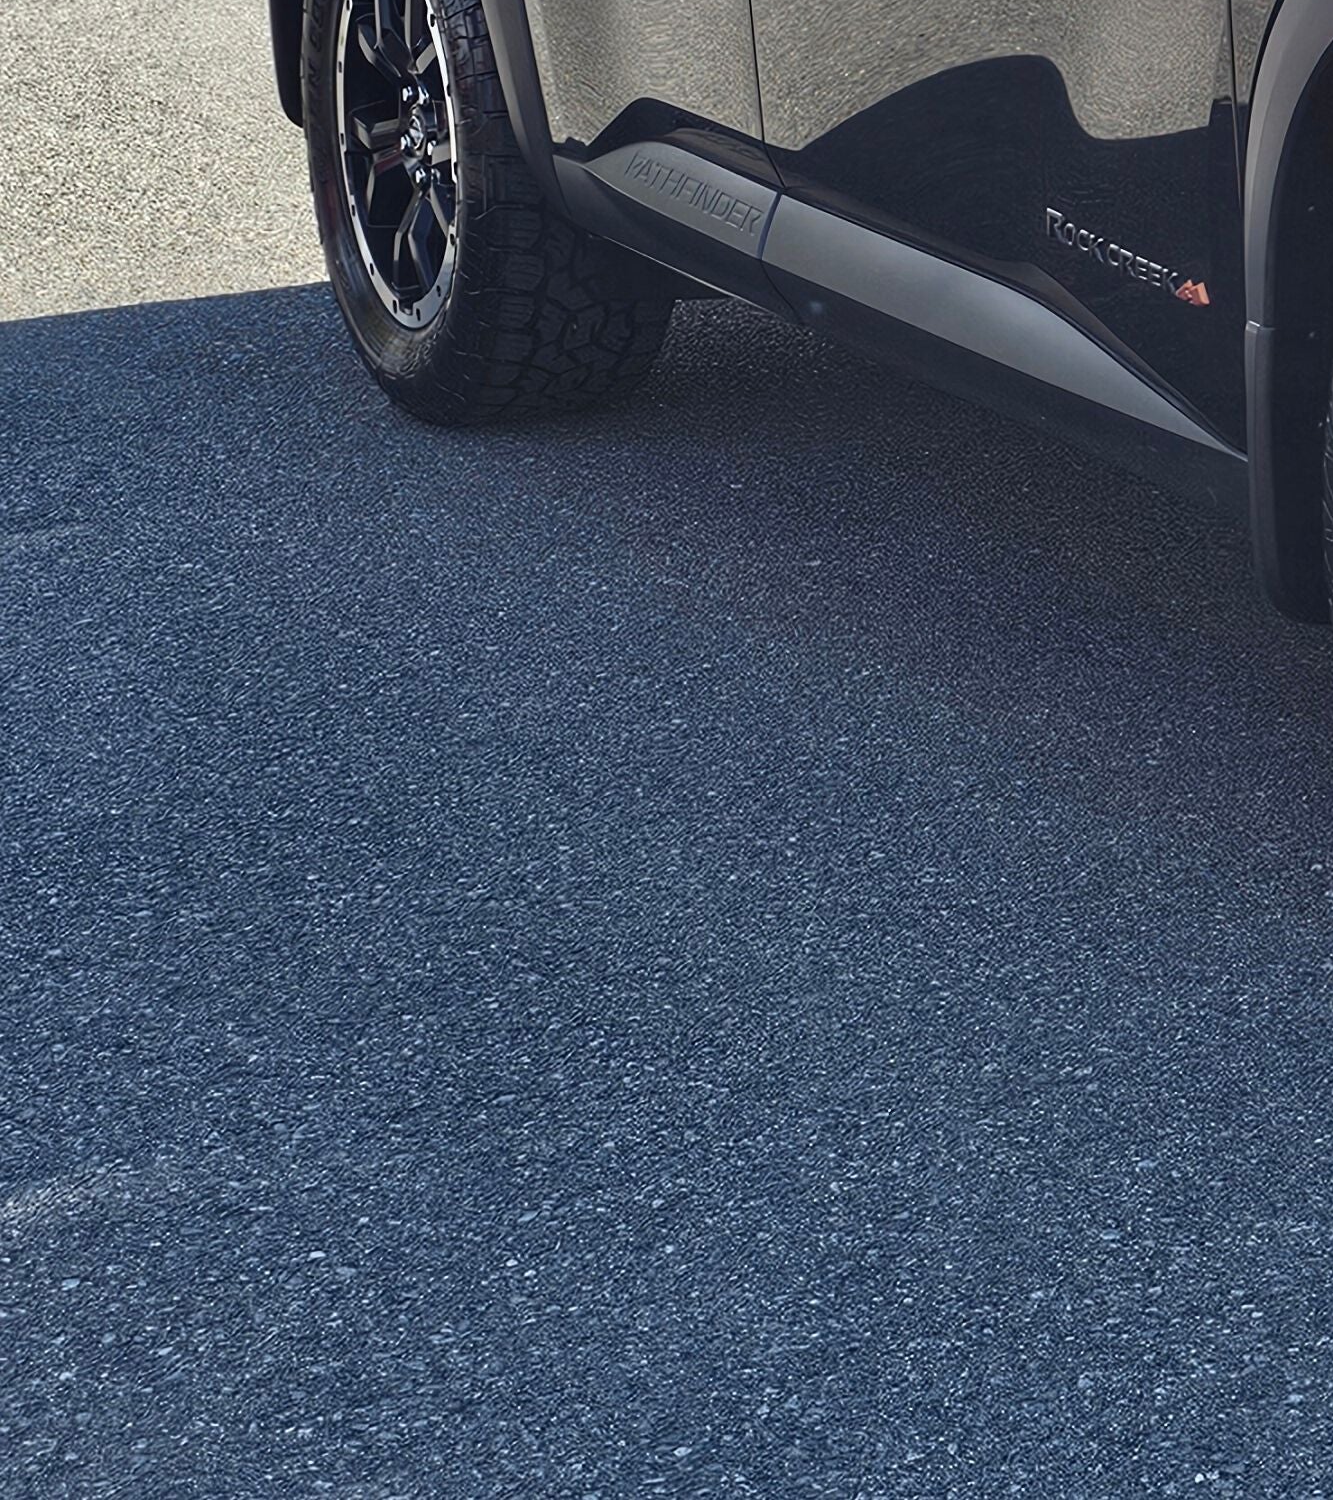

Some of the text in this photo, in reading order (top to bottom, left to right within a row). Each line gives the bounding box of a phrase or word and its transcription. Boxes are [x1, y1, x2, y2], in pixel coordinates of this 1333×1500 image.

[625, 152, 764, 236] PATHFINDER
[1046, 208, 1178, 296] ROCK CREEK
